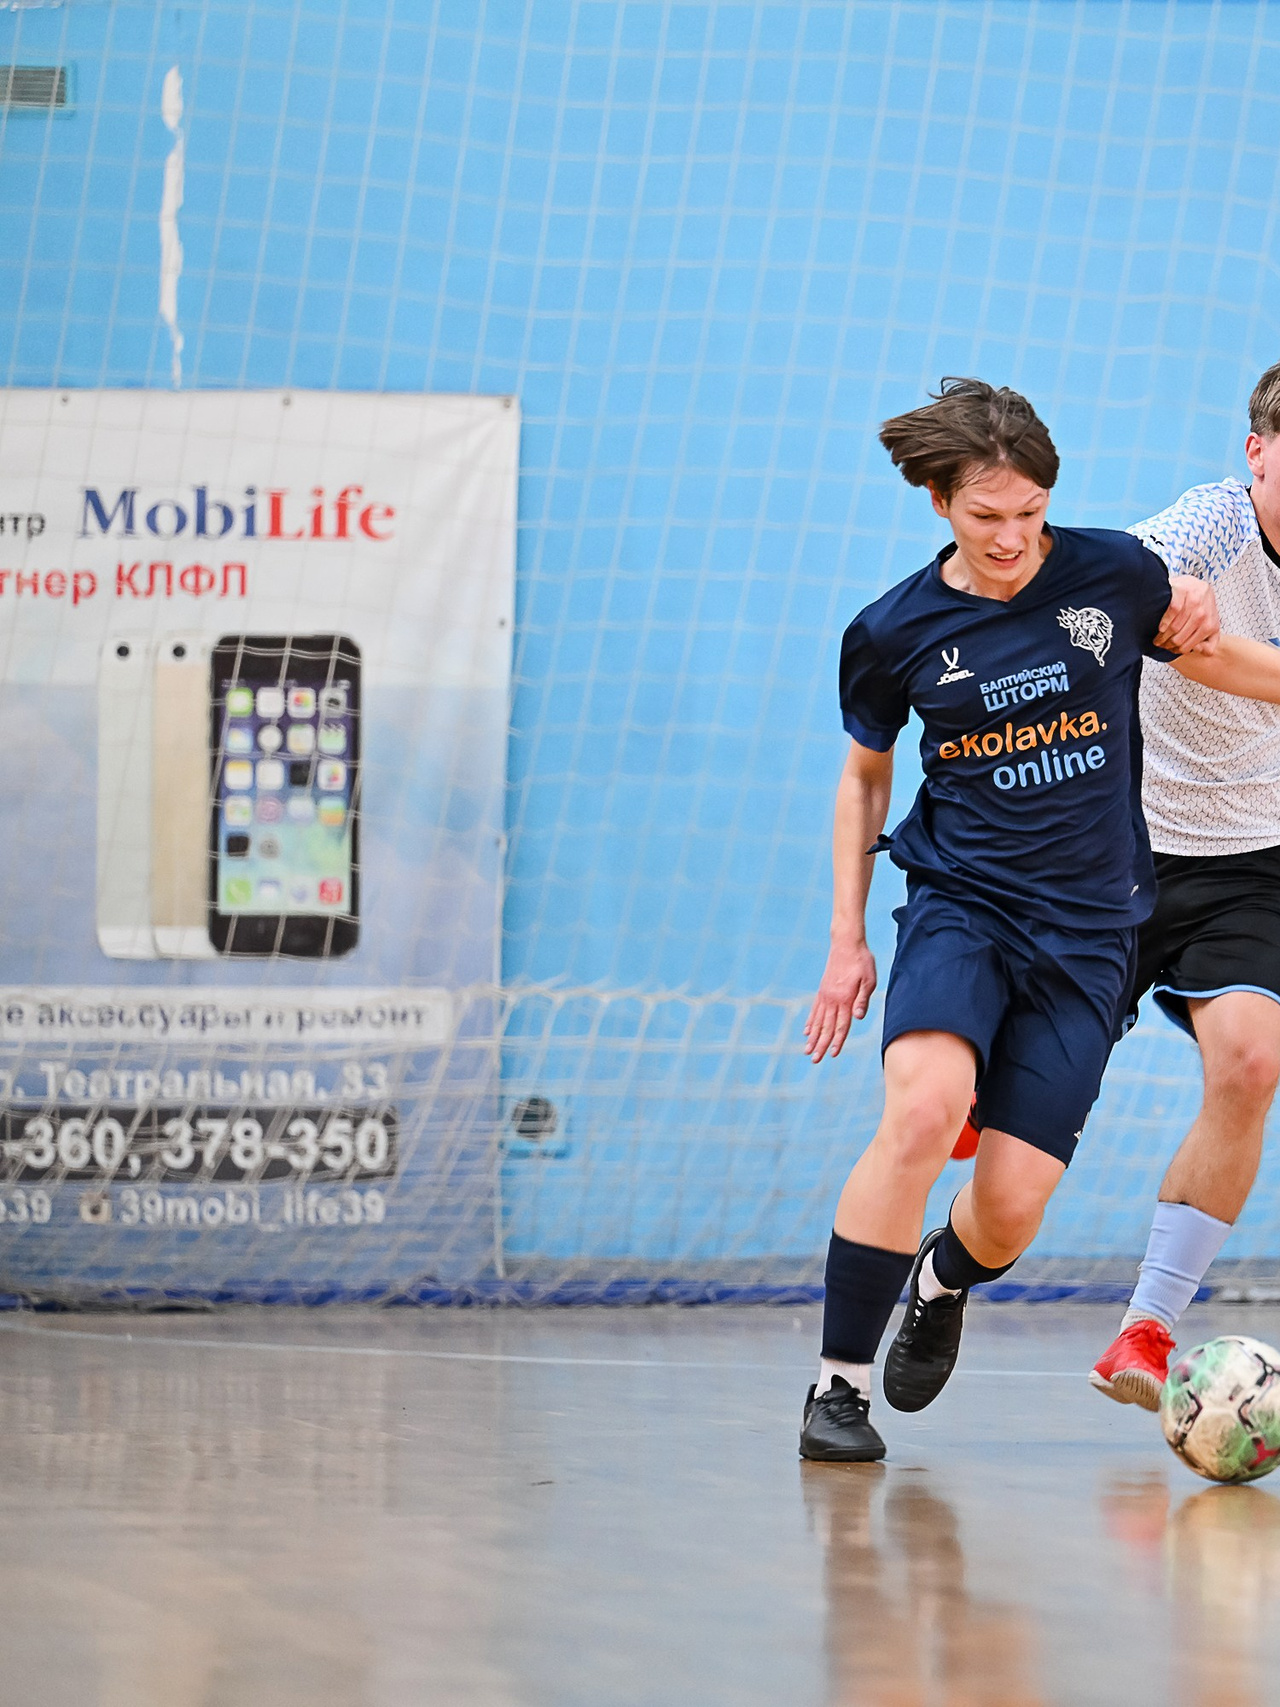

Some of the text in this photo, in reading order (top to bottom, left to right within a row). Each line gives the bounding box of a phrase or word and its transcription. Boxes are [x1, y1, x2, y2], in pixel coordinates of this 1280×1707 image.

[78, 485, 396, 541] MobiLife
[116, 562, 248, 599] КЛФЛ
[979, 661, 1067, 695] БАЛТИЙСКИЙ
[983, 674, 1070, 713] ШТОРМ
[938, 711, 1108, 760] ekolavka.
[993, 745, 1107, 790] online
[298, 1005, 426, 1033] ремонт
[161, 1117, 388, 1170] 378-350
